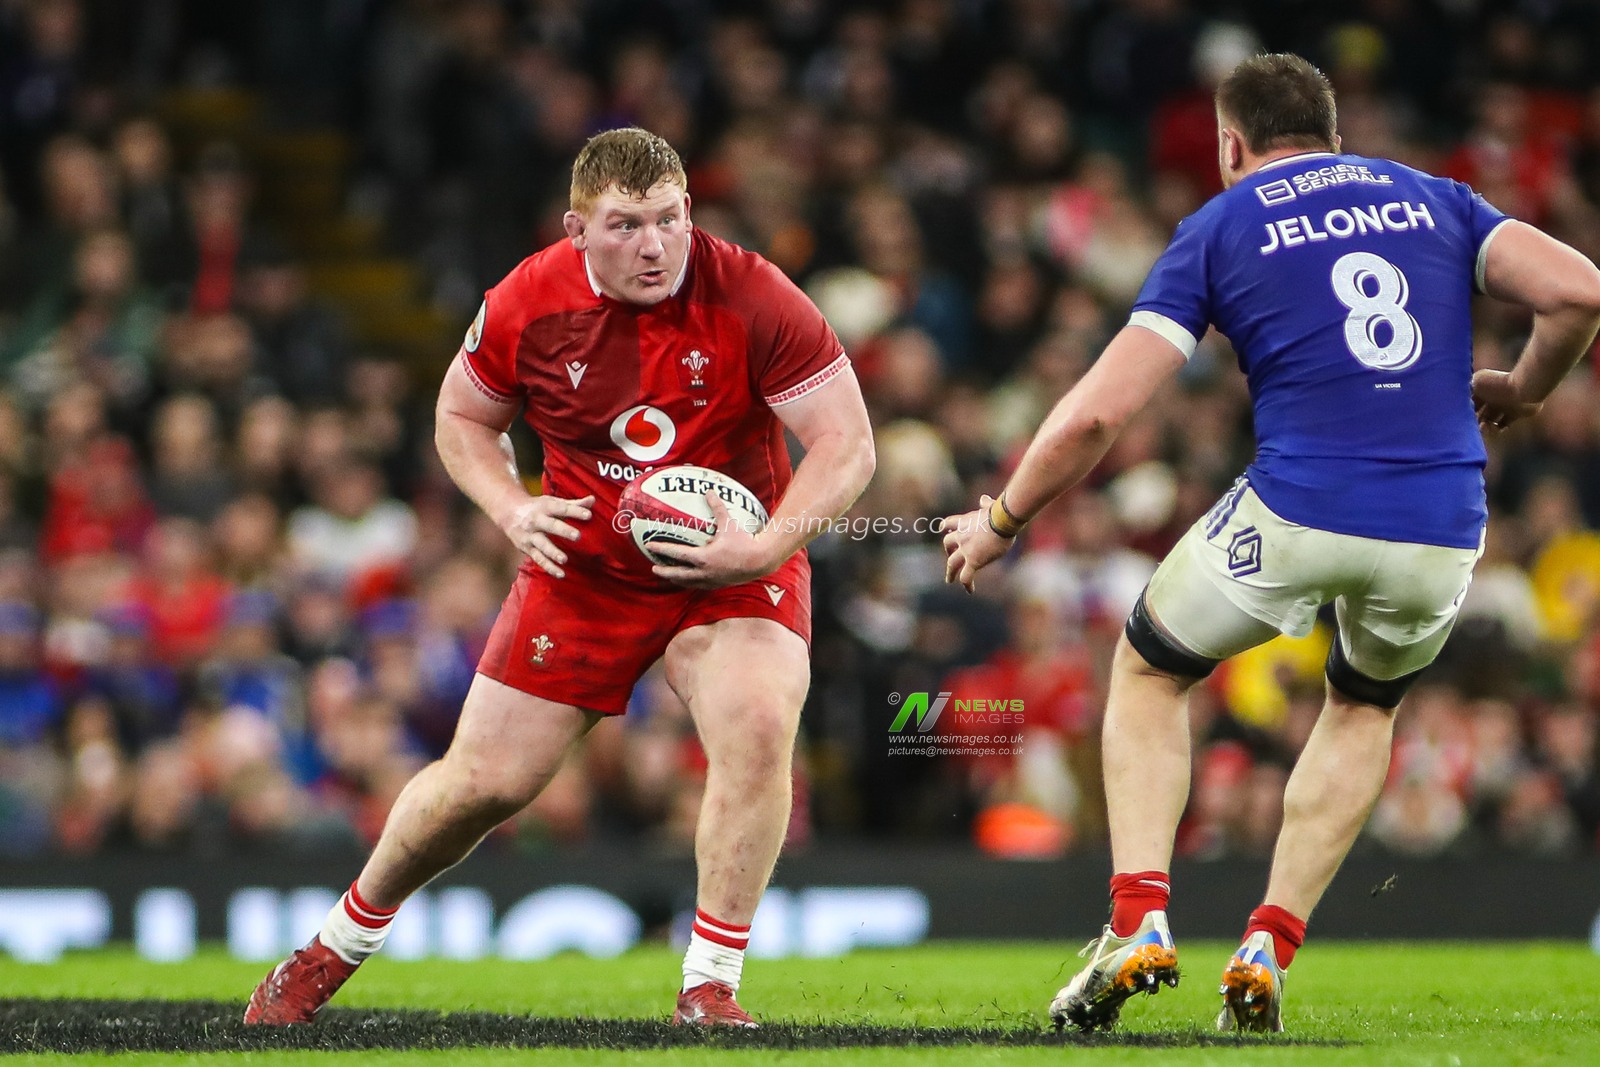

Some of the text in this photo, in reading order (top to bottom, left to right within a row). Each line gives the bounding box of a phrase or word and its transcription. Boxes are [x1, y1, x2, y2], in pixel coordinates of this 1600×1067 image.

[1292, 164, 1371, 185] SOCIETE
[1297, 171, 1393, 193] GENERALE
[1260, 201, 1436, 255] JELONCH
[1331, 251, 1423, 371] 8
[660, 476, 768, 521] ILBERT
